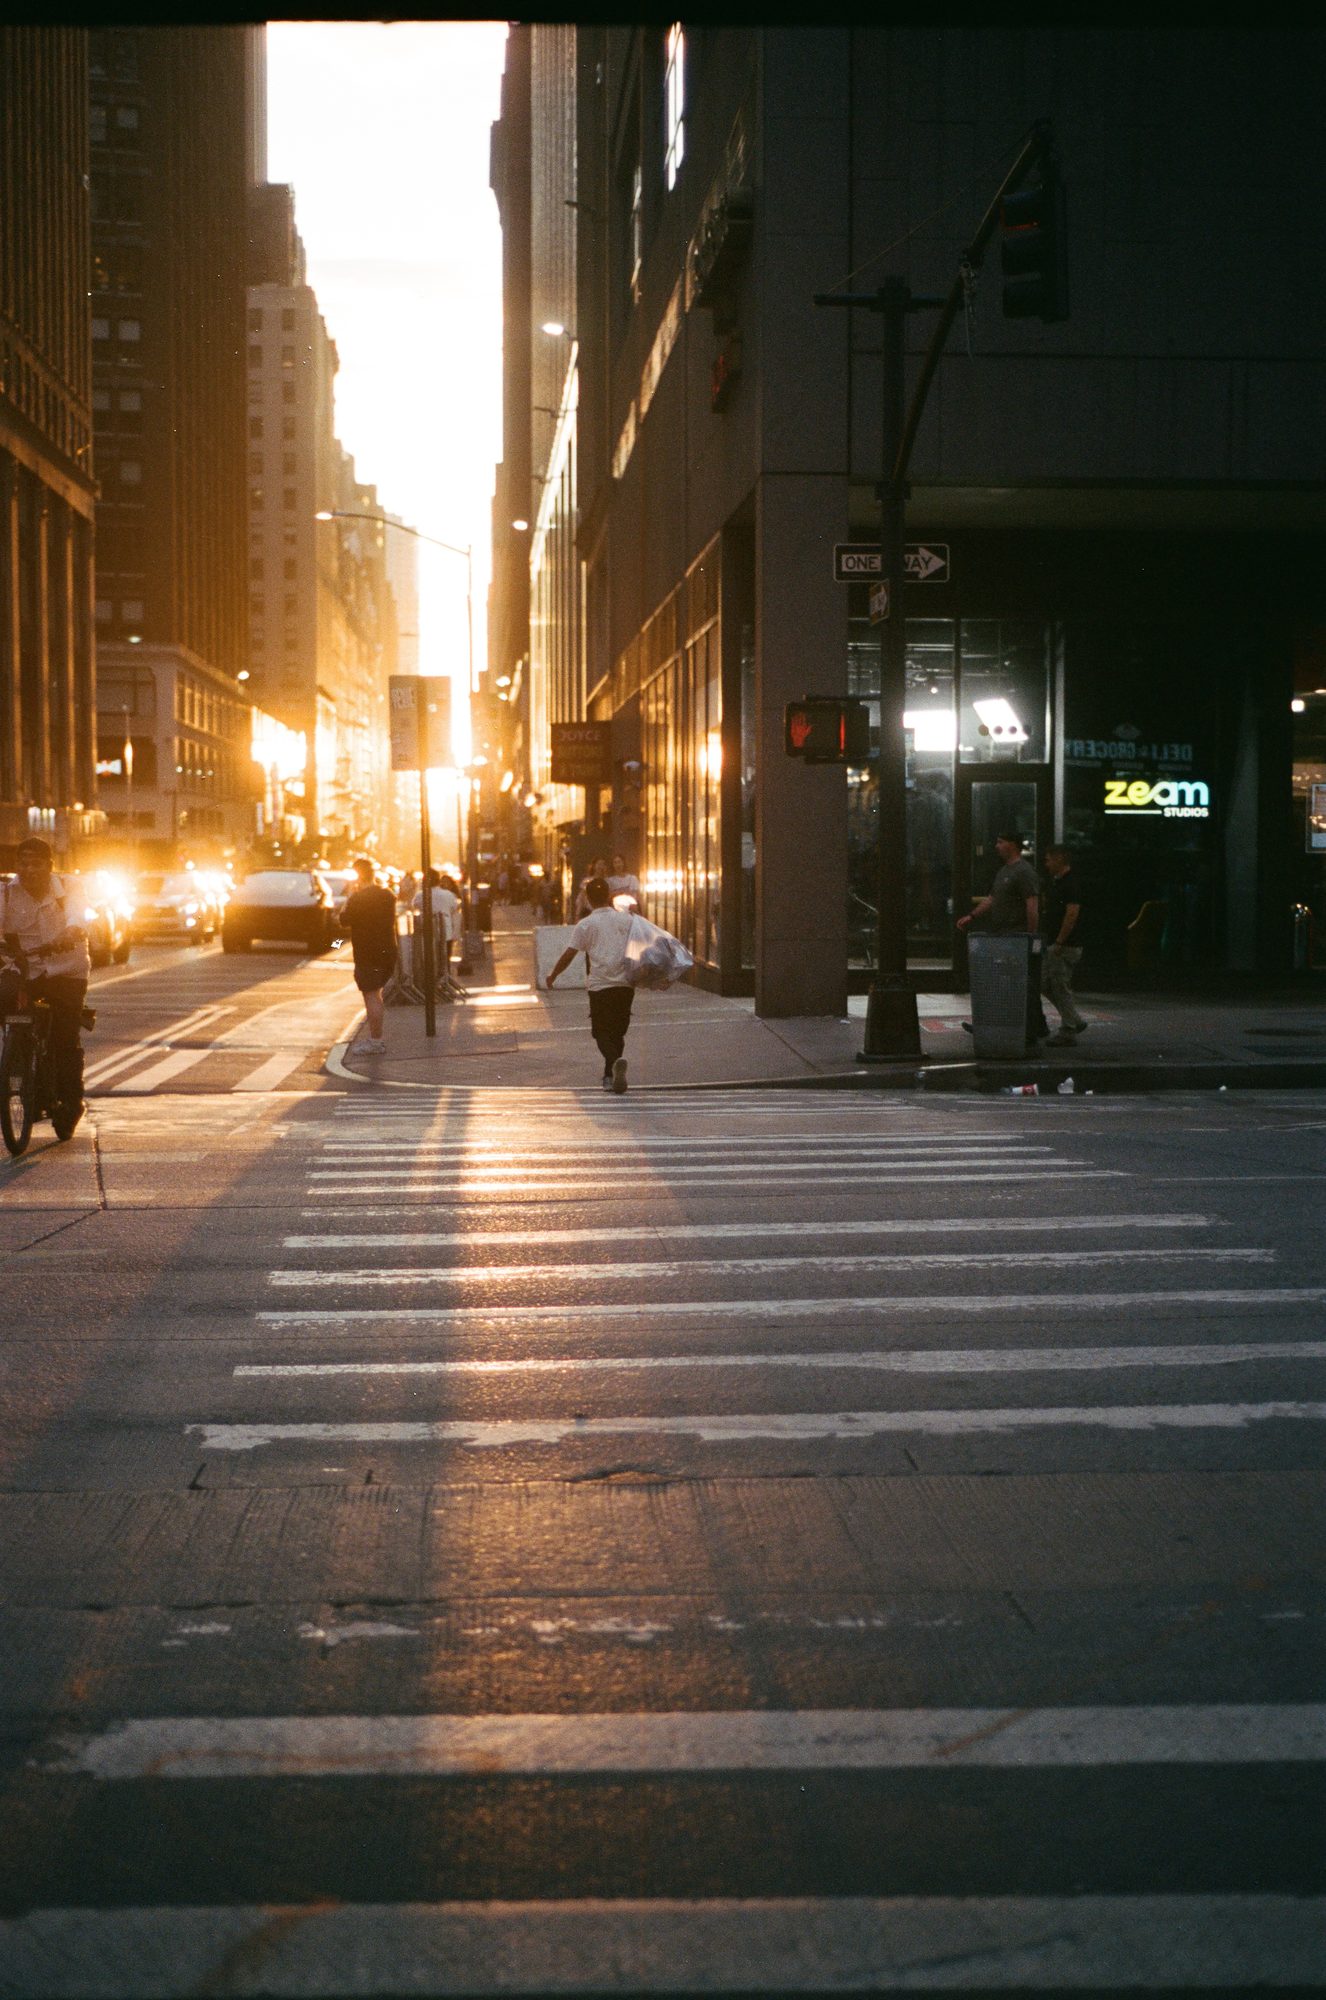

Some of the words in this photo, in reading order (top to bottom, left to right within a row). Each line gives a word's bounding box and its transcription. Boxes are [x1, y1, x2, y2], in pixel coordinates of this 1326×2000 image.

[845, 556, 878, 570] ONE
[1104, 780, 1210, 806] zeam
[1163, 807, 1210, 818] STUDIOS
